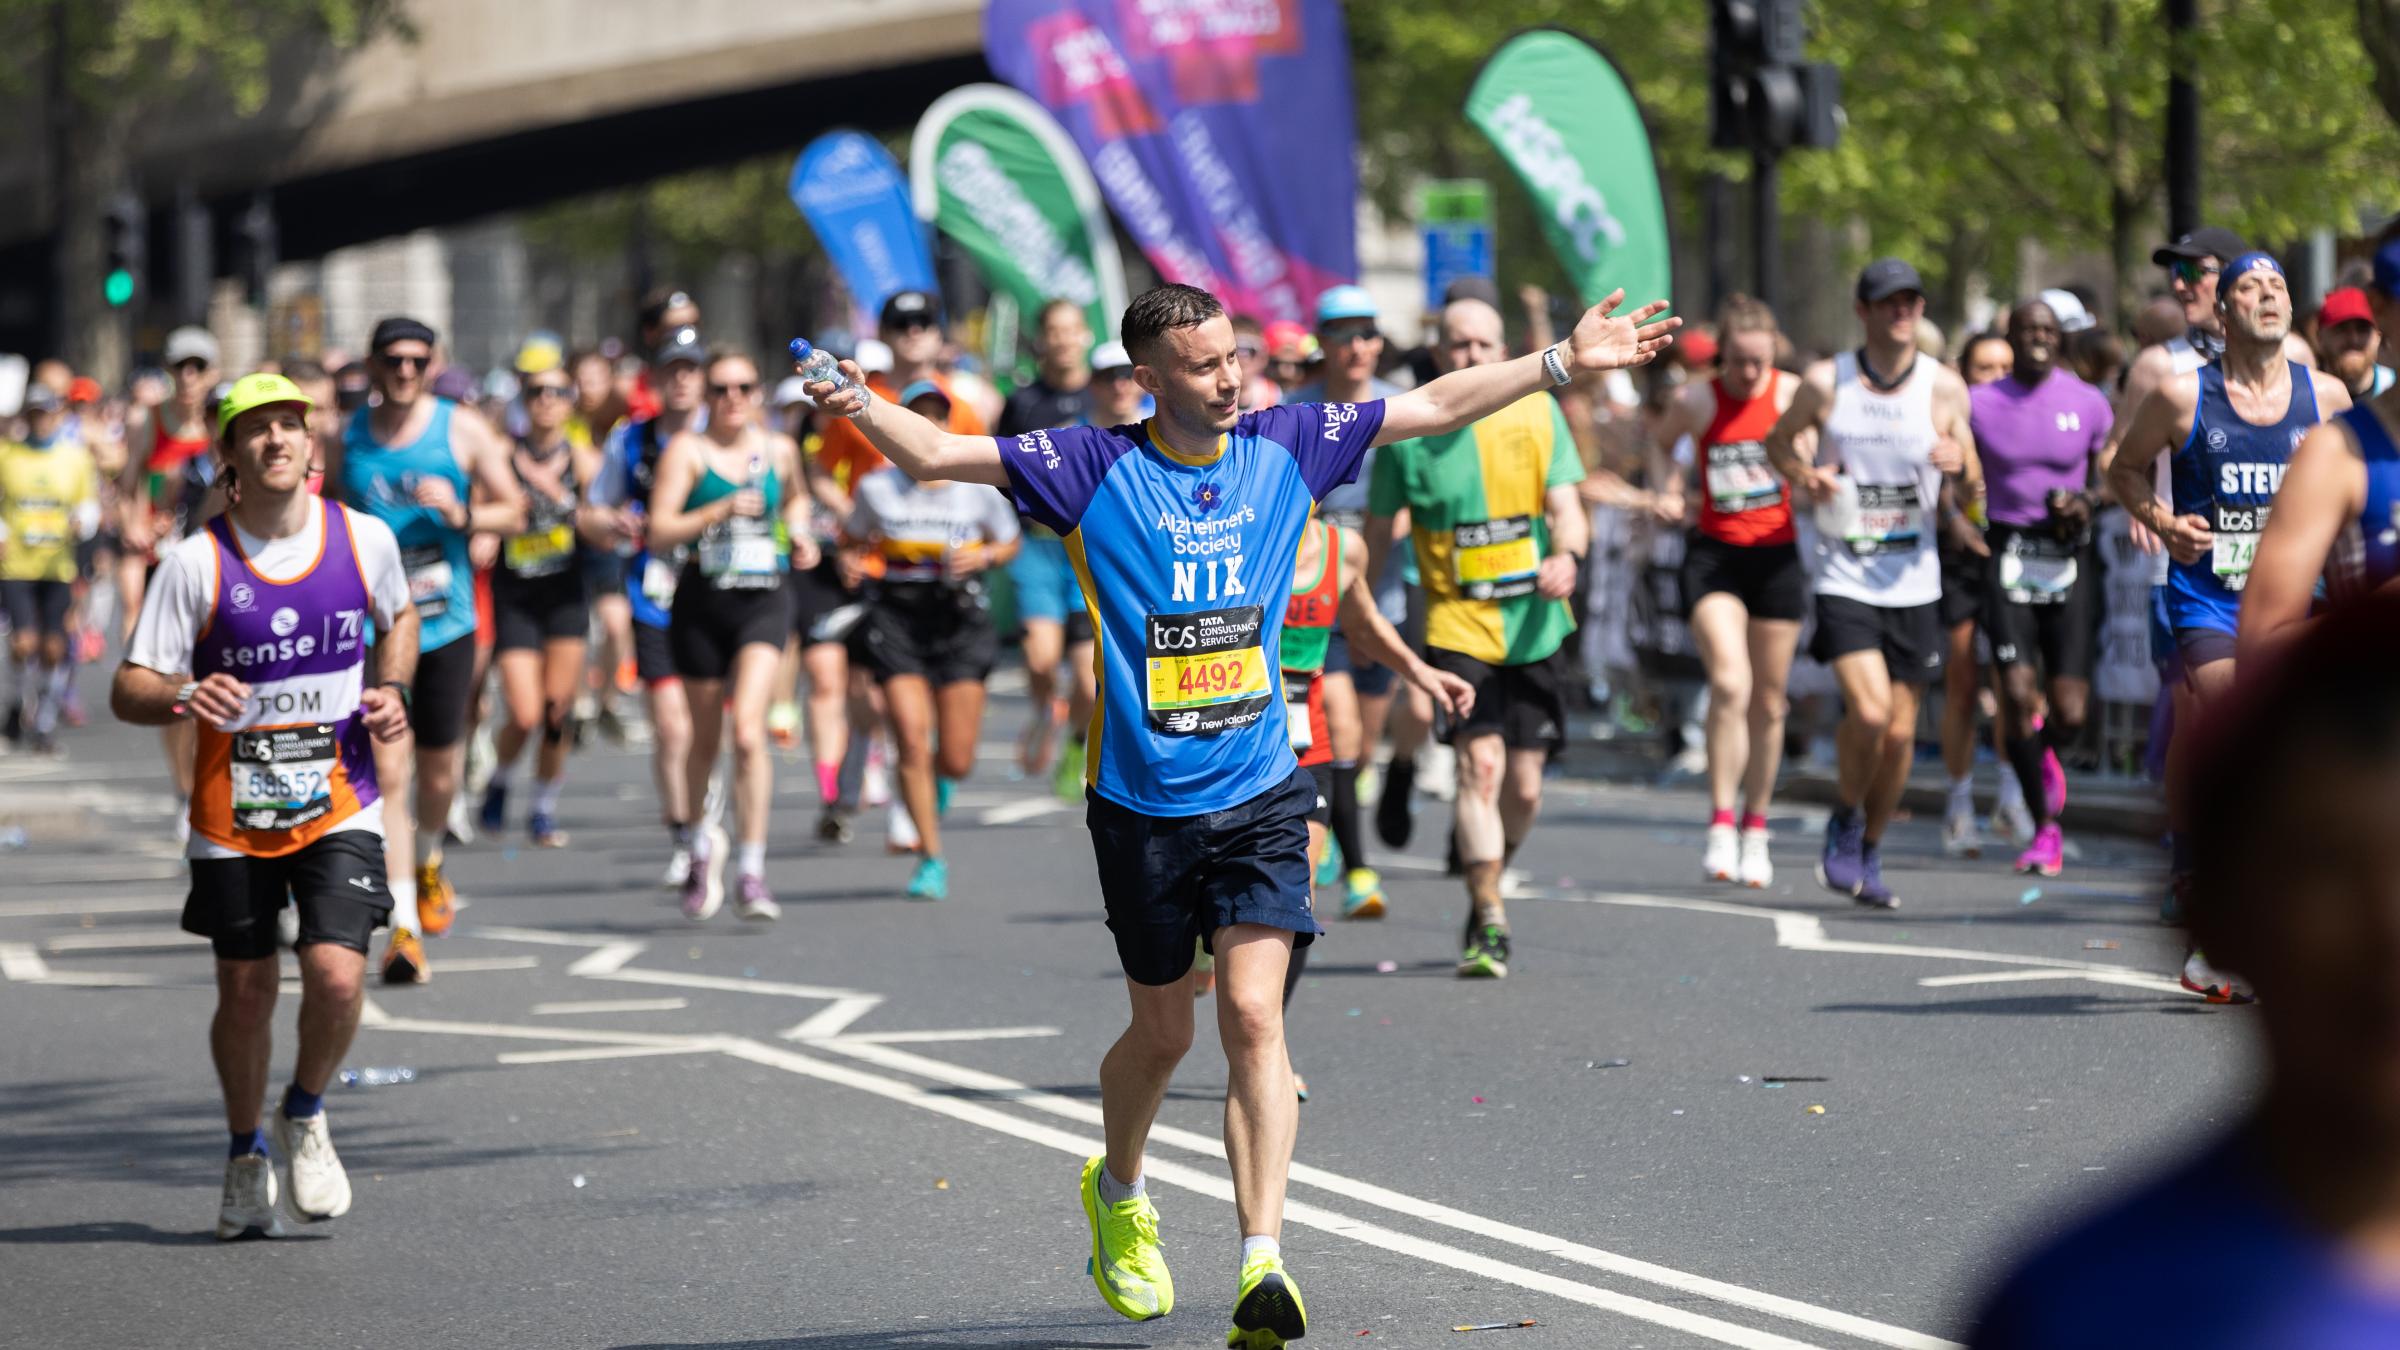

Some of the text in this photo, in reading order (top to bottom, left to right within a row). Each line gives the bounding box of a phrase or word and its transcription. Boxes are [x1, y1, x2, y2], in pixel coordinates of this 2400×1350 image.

[2220, 461, 2294, 495] STEV
[1157, 503, 1255, 535] Alzheimer's
[2219, 507, 2253, 531] tcs
[1173, 532, 1241, 555] Society
[1172, 554, 1246, 602] NIK
[1199, 616, 1225, 627] TATA
[1288, 596, 1318, 622] UE
[335, 608, 365, 639] 70
[1154, 621, 1197, 650] tcs
[1199, 622, 1259, 638] CONSULTANCY
[221, 635, 316, 667] sense
[1200, 634, 1239, 648] SERVICES
[1178, 660, 1243, 695] 4492
[256, 690, 321, 716] TOM
[1201, 718, 1224, 730] new
[249, 771, 322, 798] 58852
